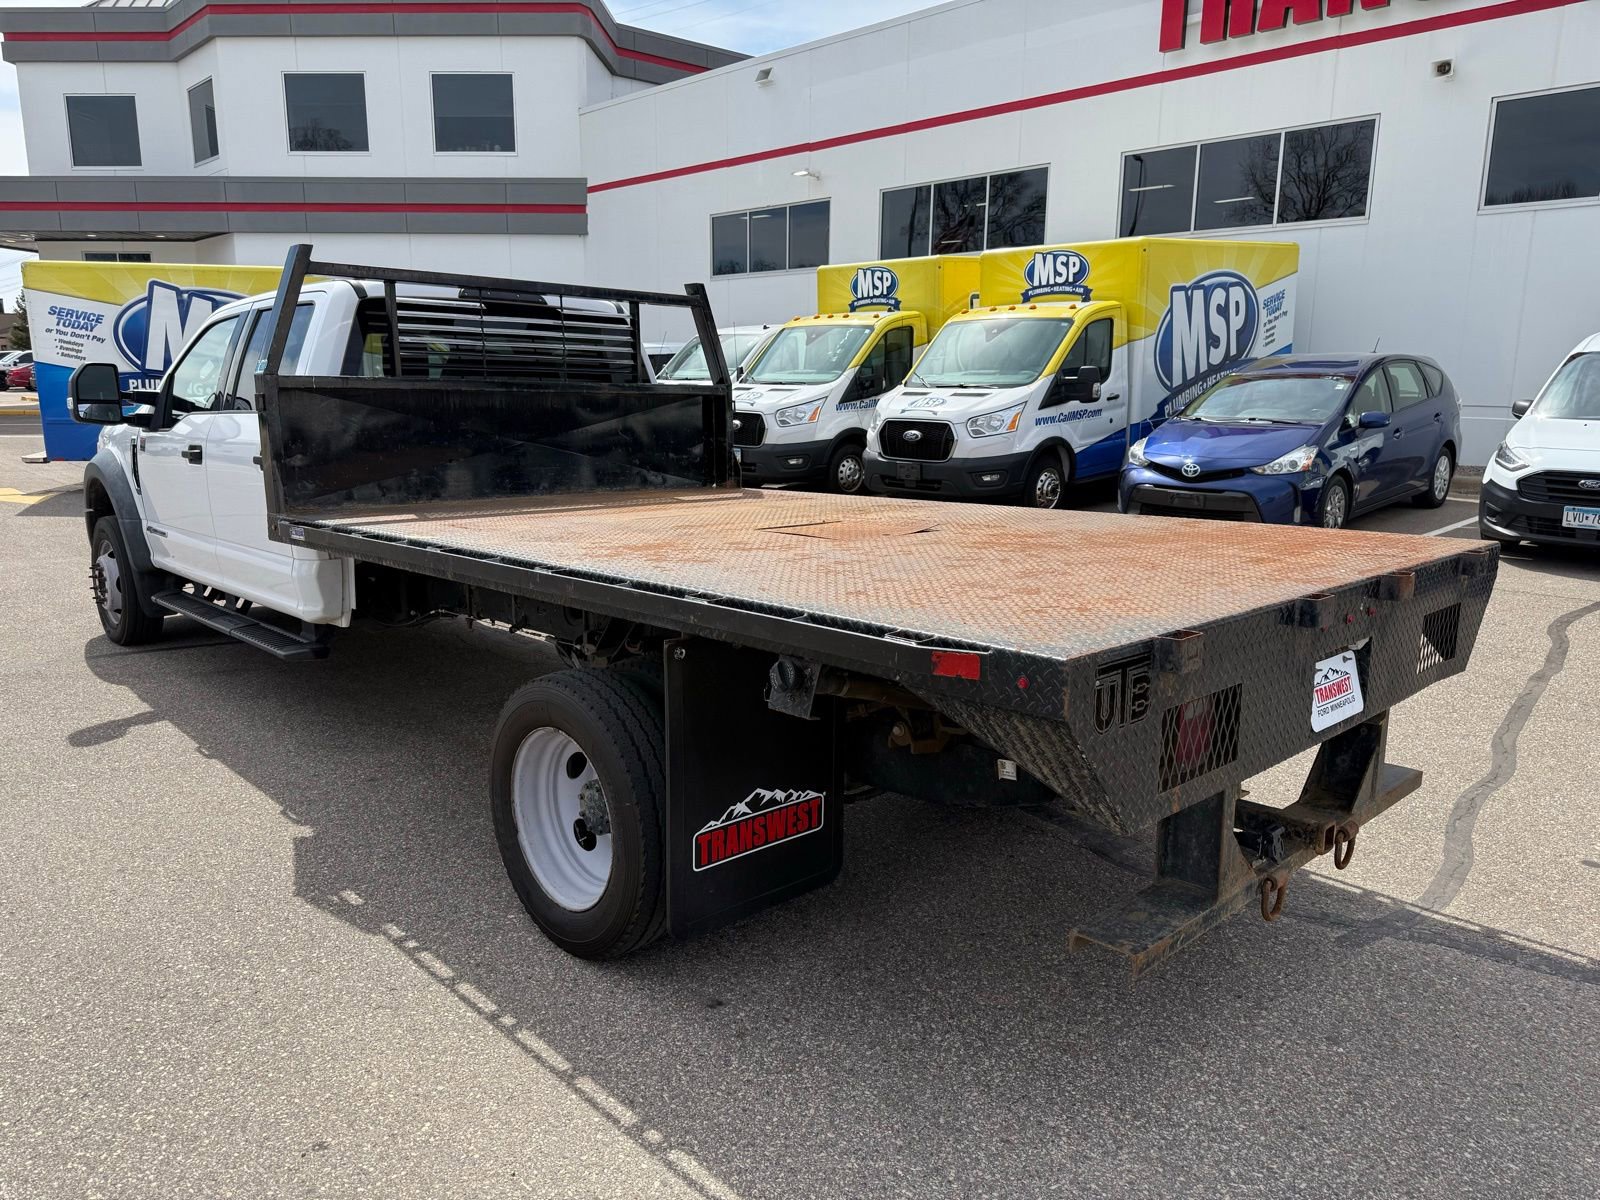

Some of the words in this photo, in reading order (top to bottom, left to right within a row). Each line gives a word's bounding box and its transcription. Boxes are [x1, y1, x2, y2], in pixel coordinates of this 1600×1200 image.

[1033, 253, 1081, 286] MSP
[857, 269, 892, 298] MSP
[47, 305, 105, 324] SERVICE
[55, 316, 98, 333] TODAY
[55, 329, 69, 337] You
[70, 331, 91, 341] Don't
[91, 335, 106, 344] Pay
[1171, 285, 1246, 389] MSP
[1164, 381, 1204, 418] PLUMBING
[1035, 408, 1103, 426] www.CallMSP.com
[1566, 512, 1585, 524] LVU
[1315, 676, 1352, 704] TRANSWEST
[1318, 707, 1330, 718] FORD
[1330, 695, 1356, 713] MINNEAPOLIS
[698, 798, 822, 866] TRANSWEST
